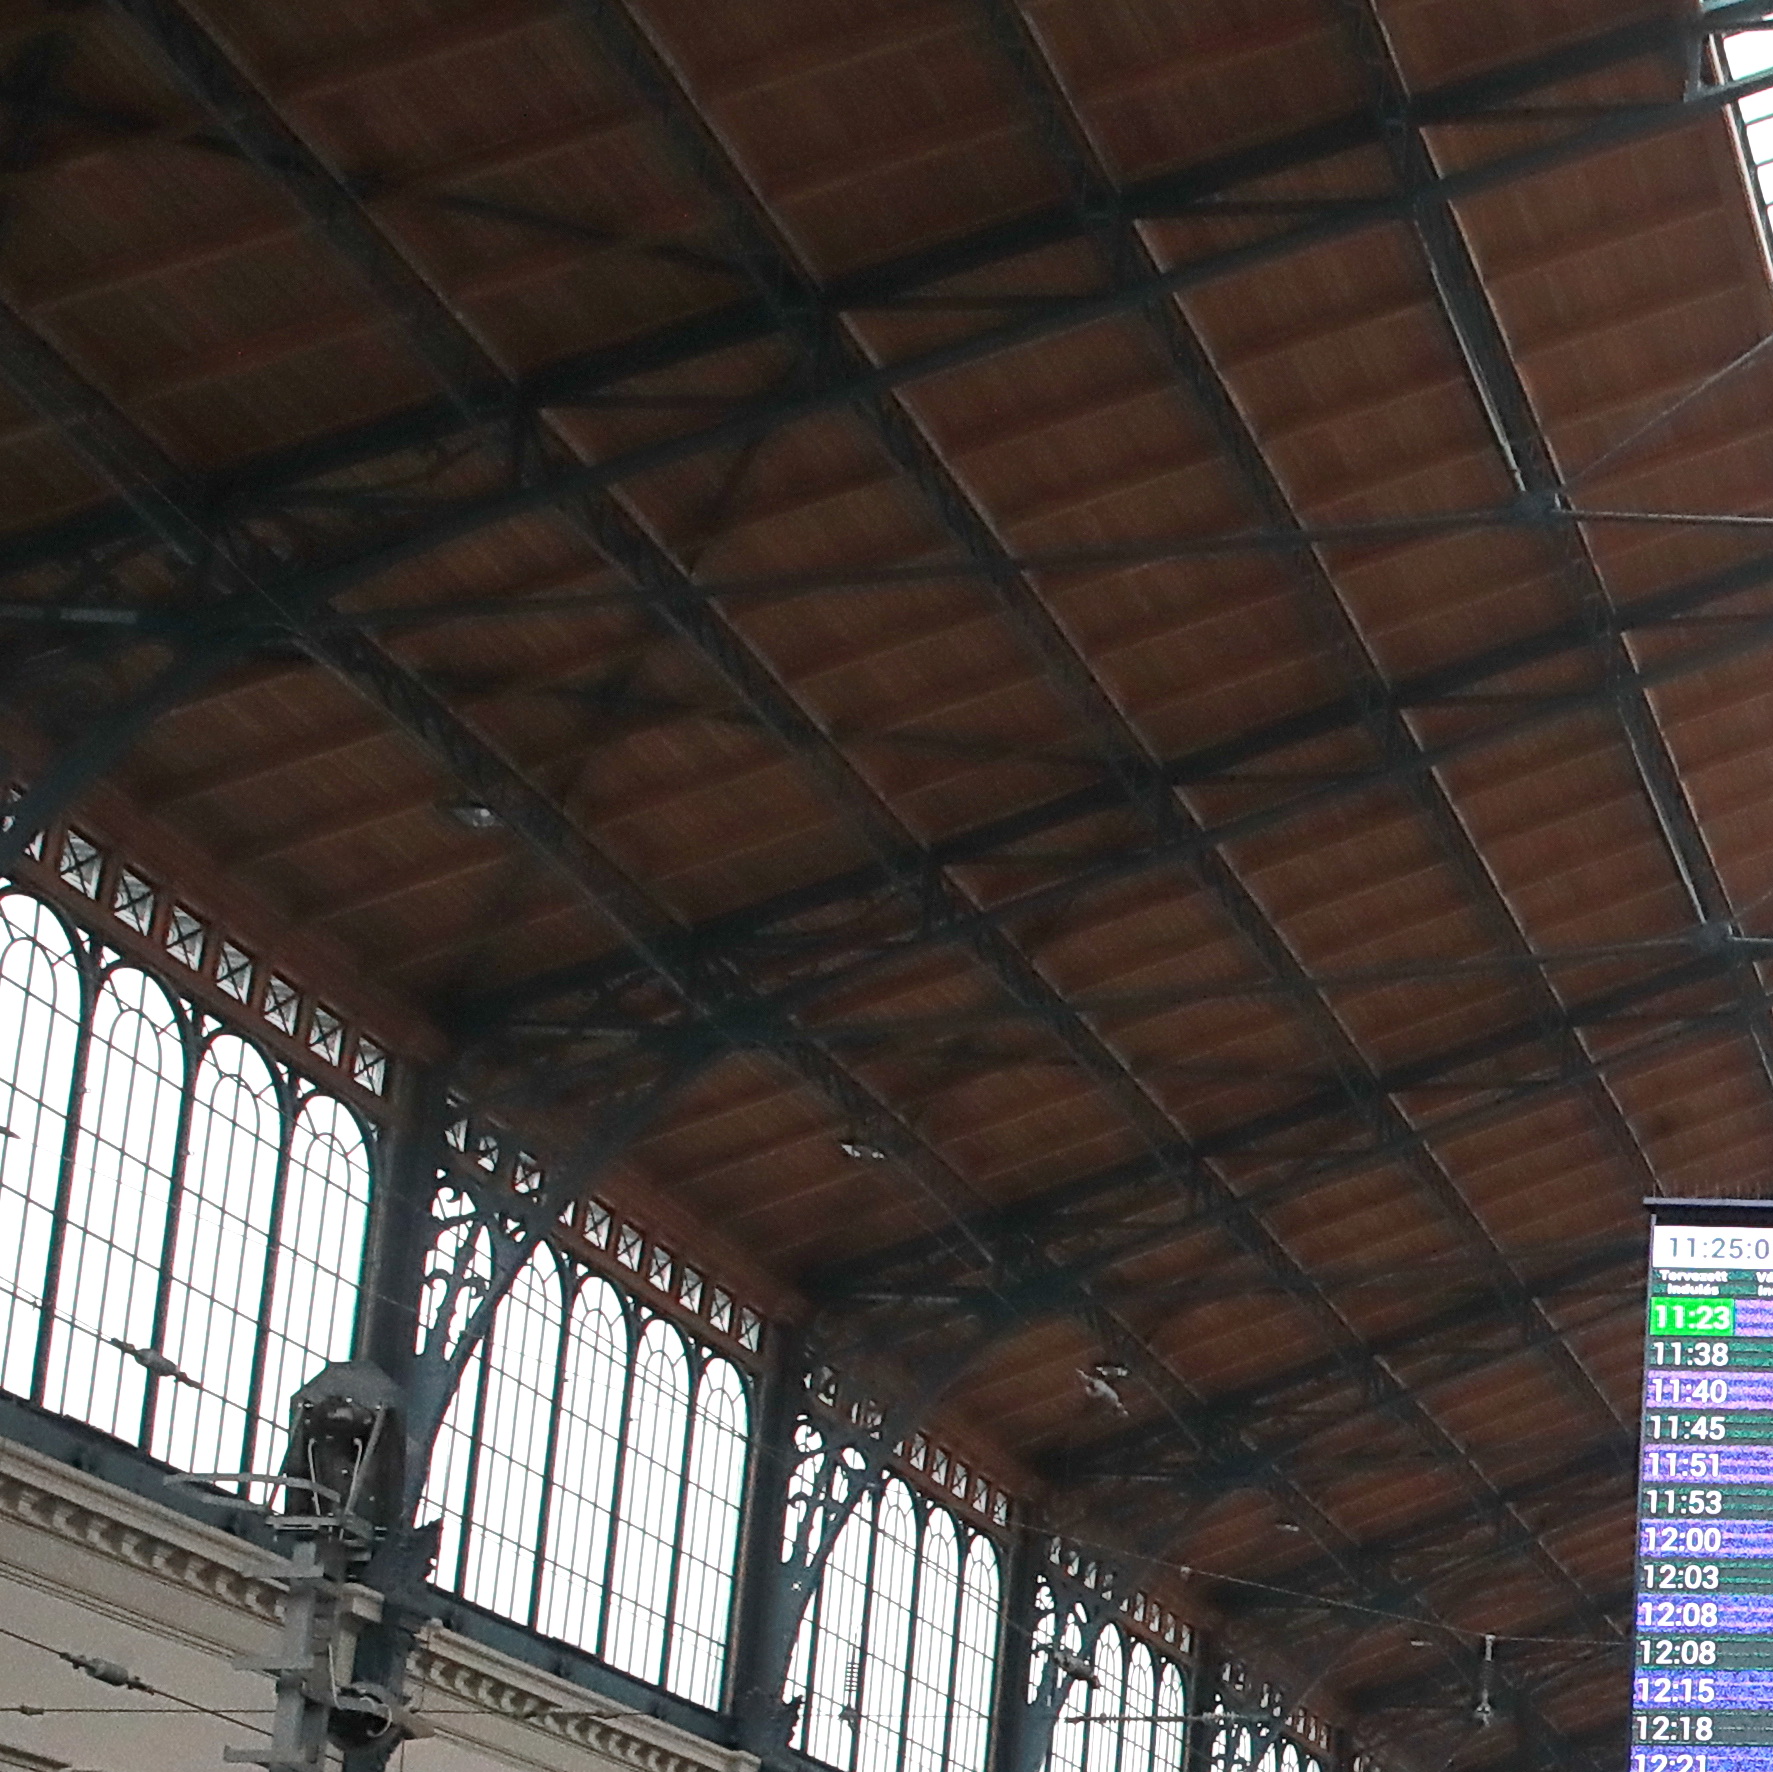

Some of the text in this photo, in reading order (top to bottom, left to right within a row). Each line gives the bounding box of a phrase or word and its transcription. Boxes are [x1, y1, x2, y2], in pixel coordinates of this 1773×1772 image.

[1655, 1304, 1729, 1330] 11:23
[1653, 1343, 1729, 1367] 11:38
[1652, 1380, 1727, 1404] 11:40
[1650, 1416, 1726, 1440] 11:45
[1646, 1490, 1722, 1515] 11:53
[1646, 1528, 1720, 1552] 12:00
[1644, 1565, 1719, 1589] 12:03
[1642, 1603, 1717, 1626] 12:08
[1636, 1717, 1712, 1740] 12:18
